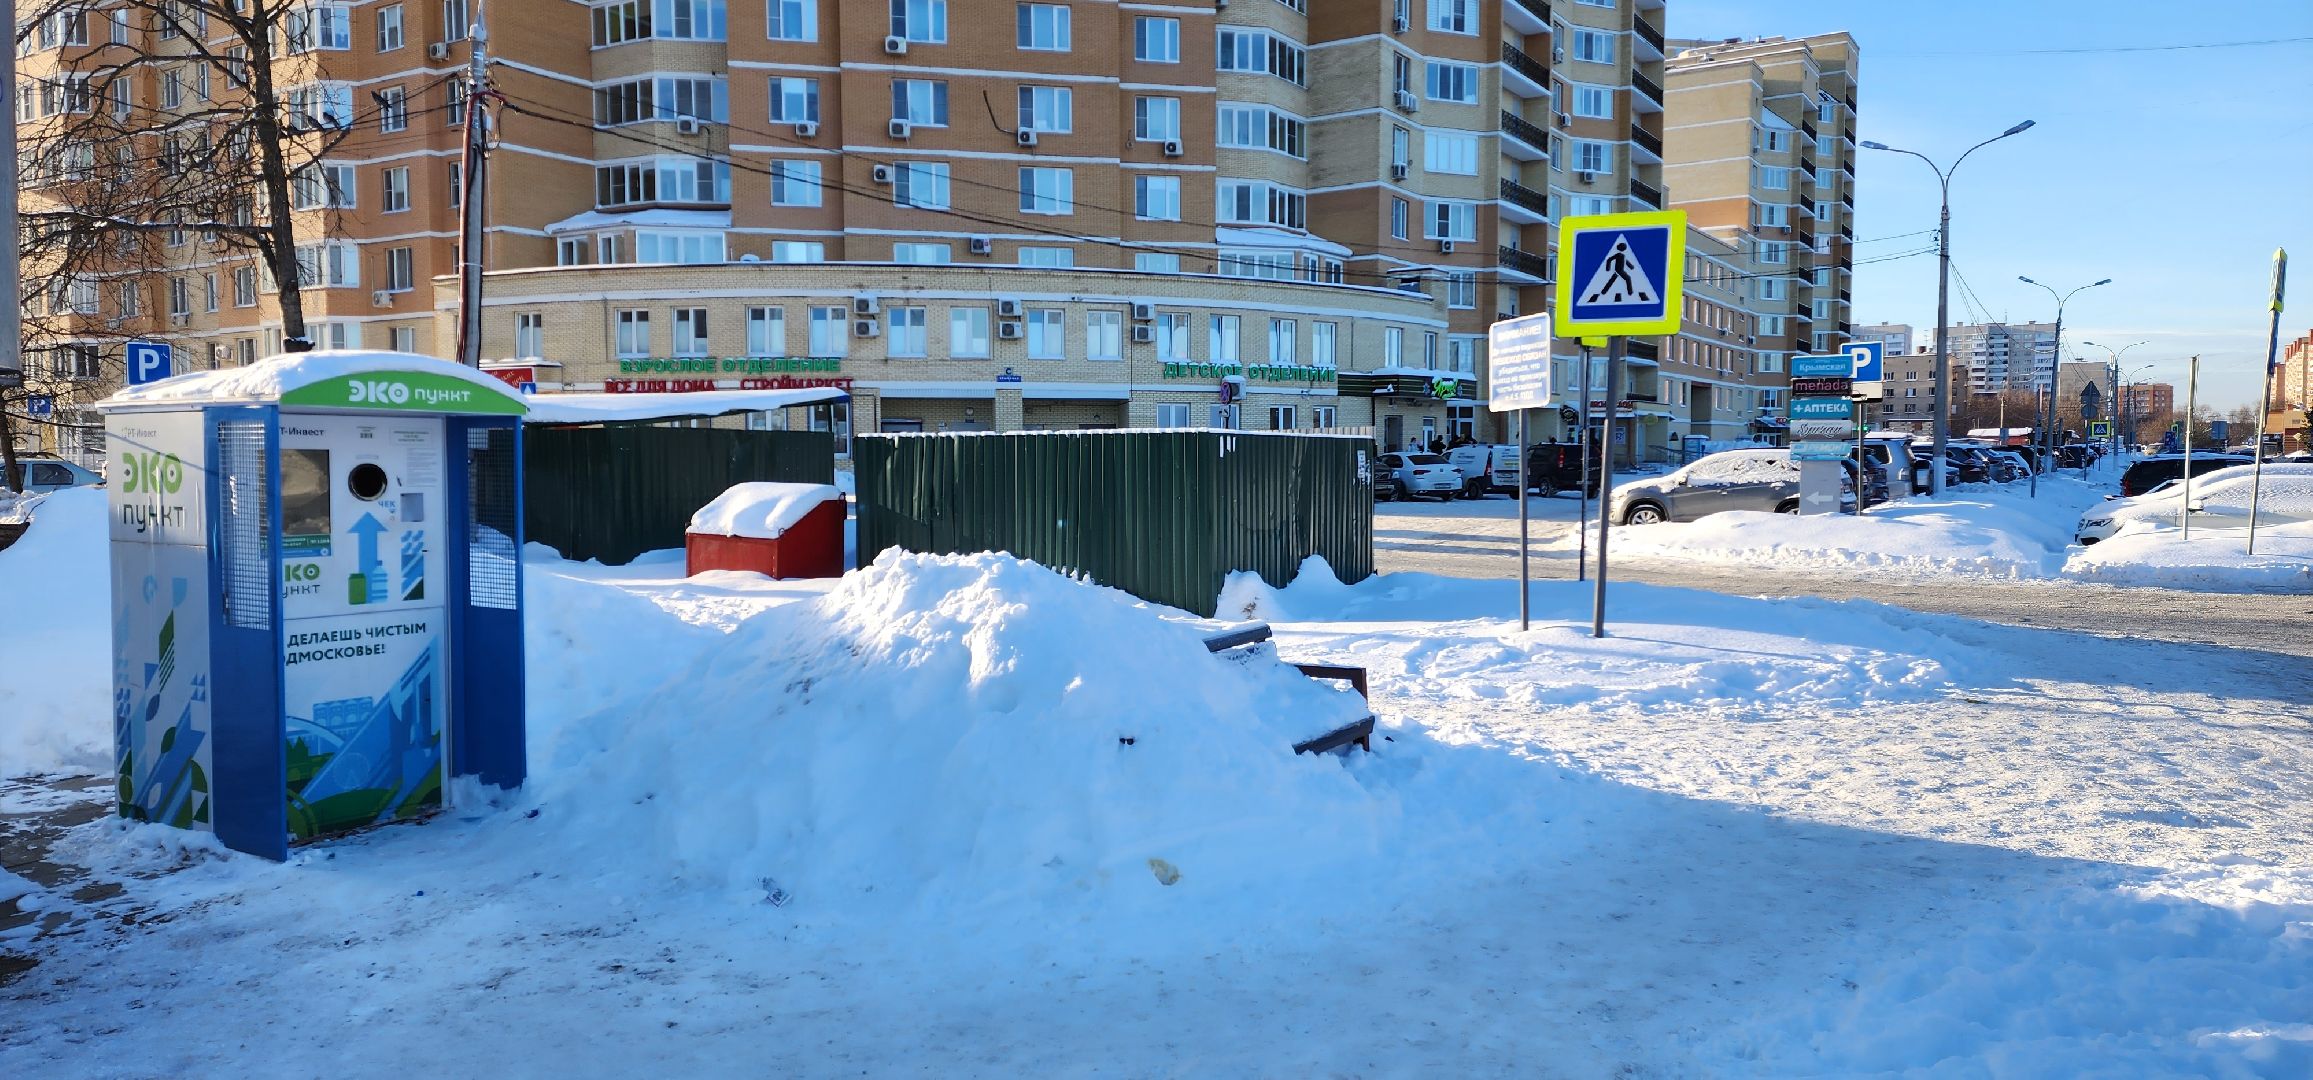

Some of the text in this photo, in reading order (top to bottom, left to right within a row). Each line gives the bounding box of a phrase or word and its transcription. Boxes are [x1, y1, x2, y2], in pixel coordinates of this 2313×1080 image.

[138, 349, 160, 381] P
[619, 357, 842, 375] ВЗРОСЛОЕ ОТДЕЛЕНИЕ
[1163, 362, 1338, 382] ДЕТСКОЕ ОТДЕЛЕНИЕ
[1852, 348, 1872, 378] P
[348, 380, 471, 404] ЭКО пункт
[604, 375, 854, 393] ВСЕ ДЛЯ ДОМА СТРОЙМАРКЕТ
[1804, 403, 1849, 413] АПТЕКА
[122, 452, 183, 495] ЭКО
[378, 500, 396, 509] ЧЕК
[123, 503, 184, 533] пункт
[287, 622, 427, 648] ДЕЛАЕШЬ ЧИСТЫМ
[284, 643, 386, 667] ДМОСКОВЬЕ!
